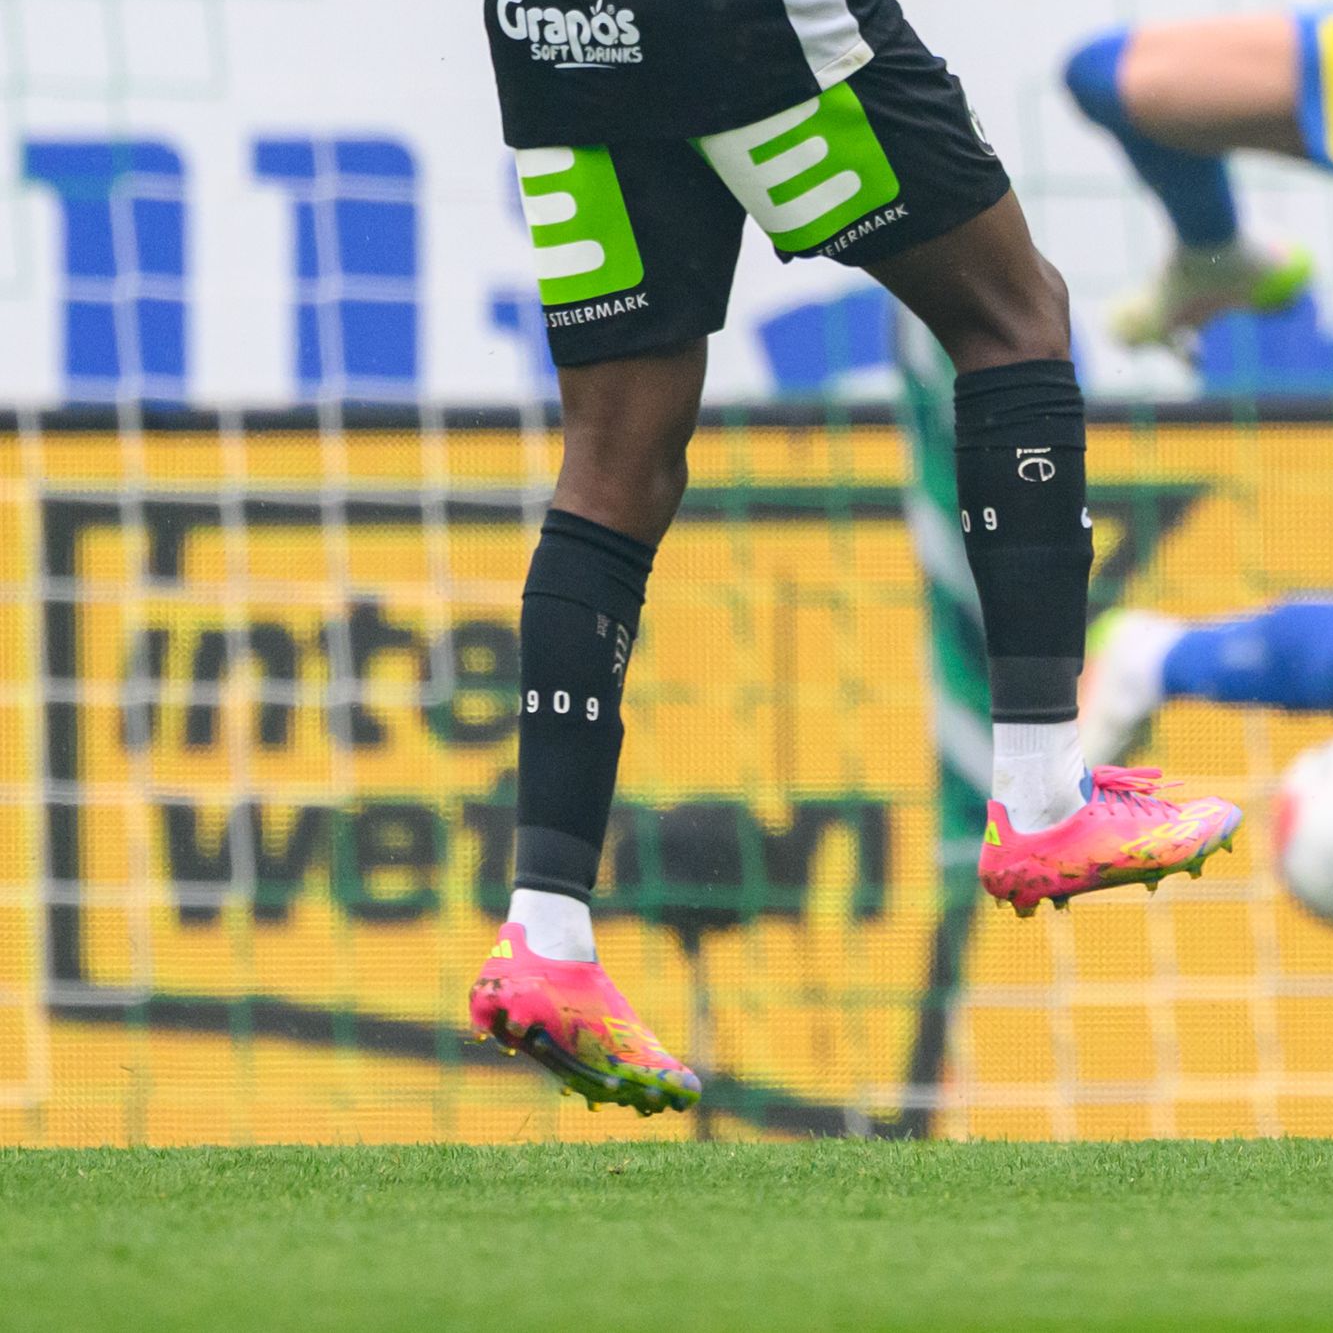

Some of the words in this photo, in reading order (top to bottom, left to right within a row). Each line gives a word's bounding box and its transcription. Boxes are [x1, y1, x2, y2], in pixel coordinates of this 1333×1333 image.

[531, 43, 570, 62] SOFT
[584, 45, 643, 64] DRINKS
[816, 203, 909, 257] TEIERMARK
[549, 292, 649, 327] STEIERMARK
[519, 689, 599, 721] 909
